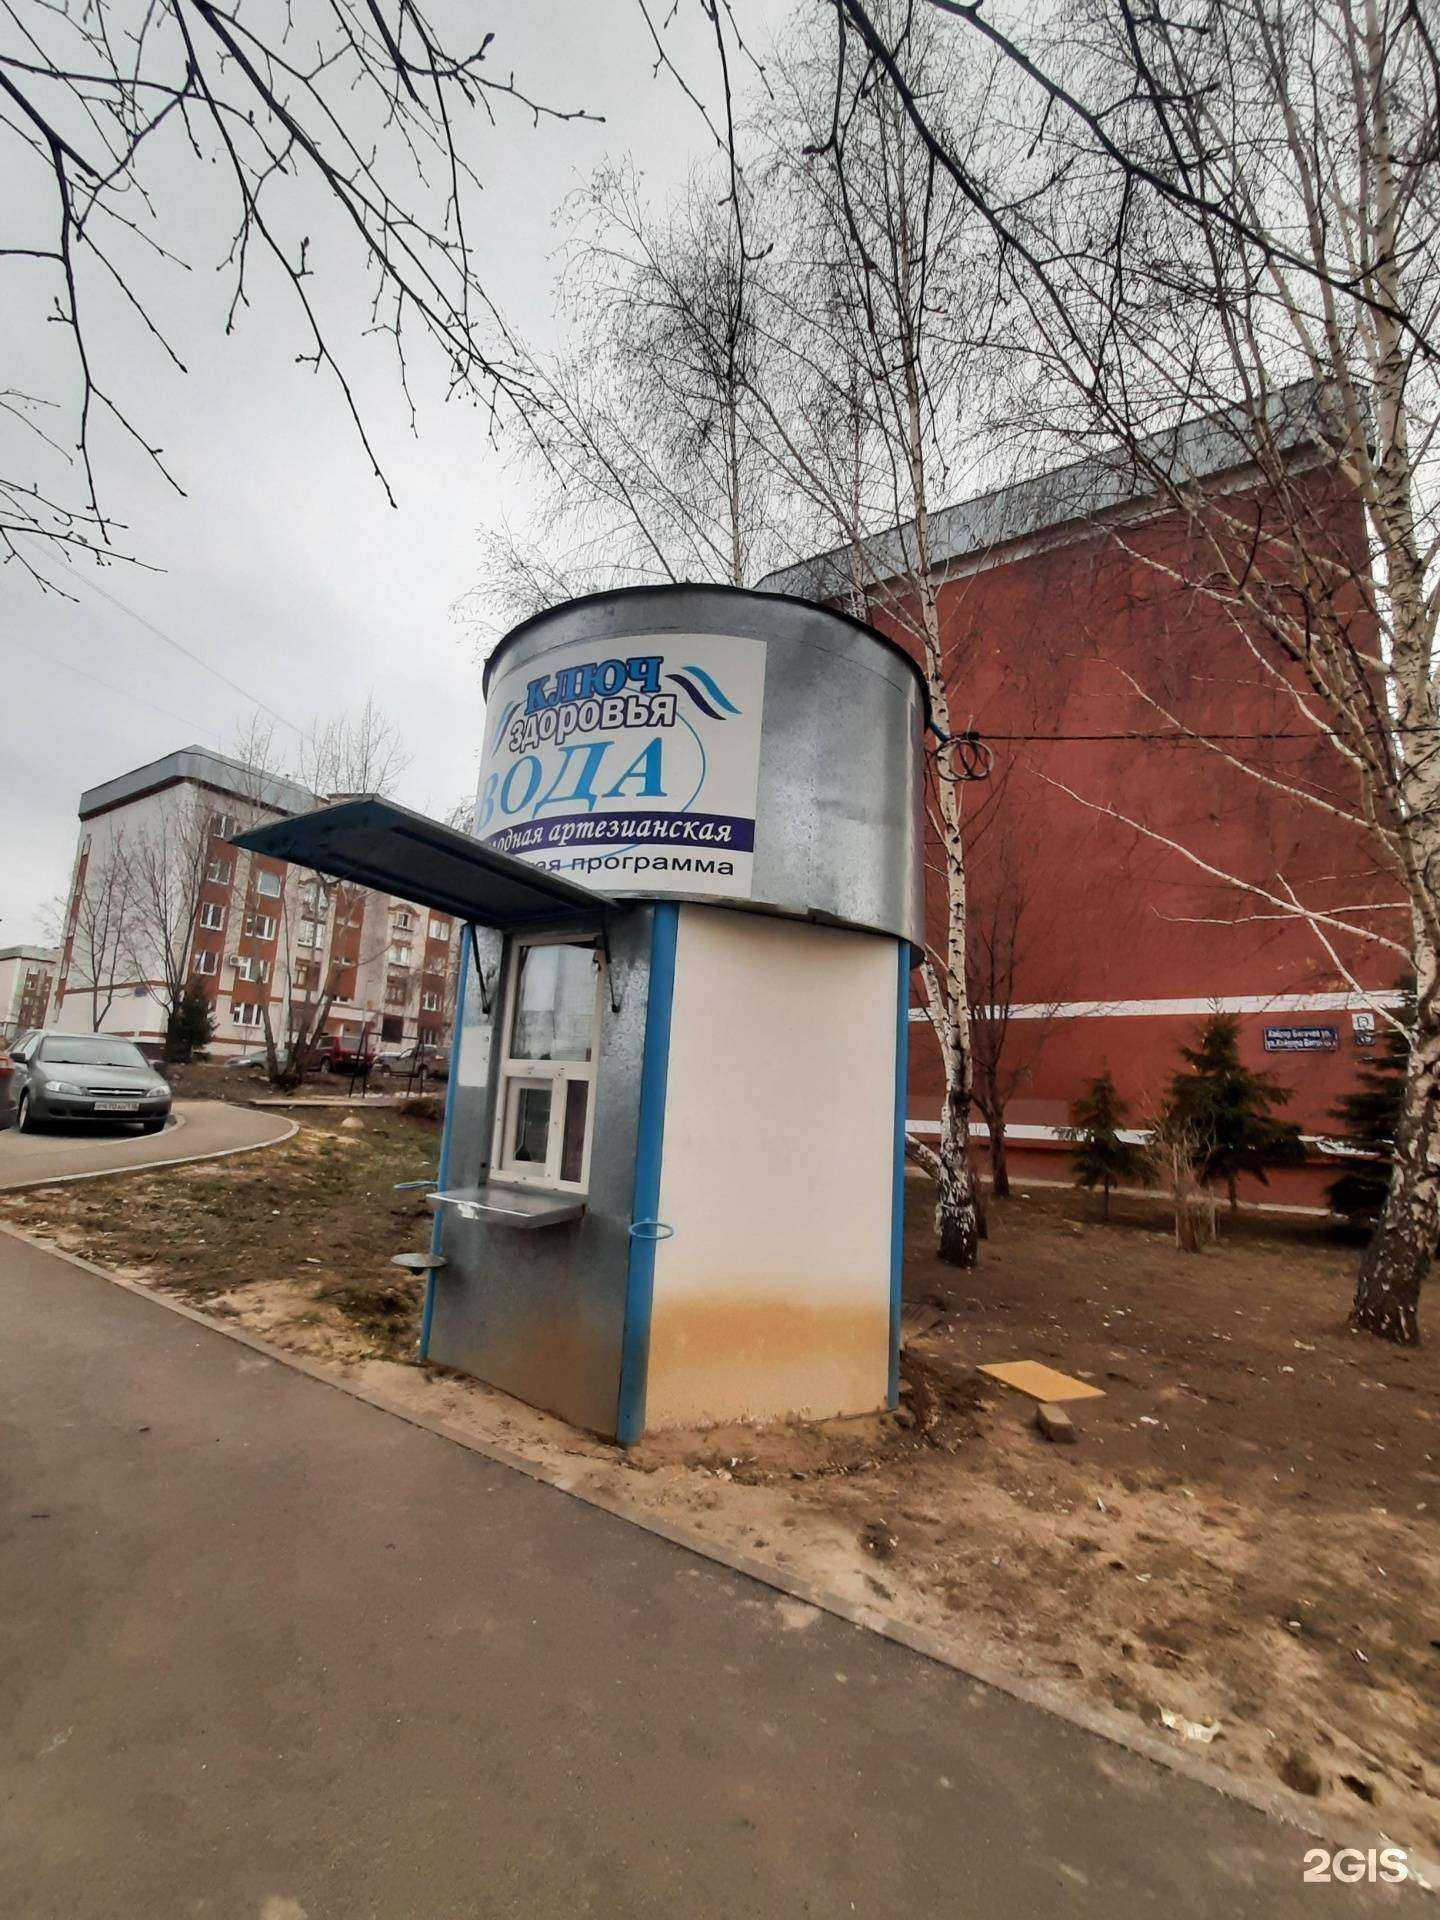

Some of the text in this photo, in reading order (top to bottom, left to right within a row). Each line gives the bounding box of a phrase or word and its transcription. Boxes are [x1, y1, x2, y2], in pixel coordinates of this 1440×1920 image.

[524, 656, 664, 715] КЛЮЧ
[476, 737, 667, 833] ВОДА
[492, 819, 732, 852] одная артезианская
[571, 856, 734, 875] программа
